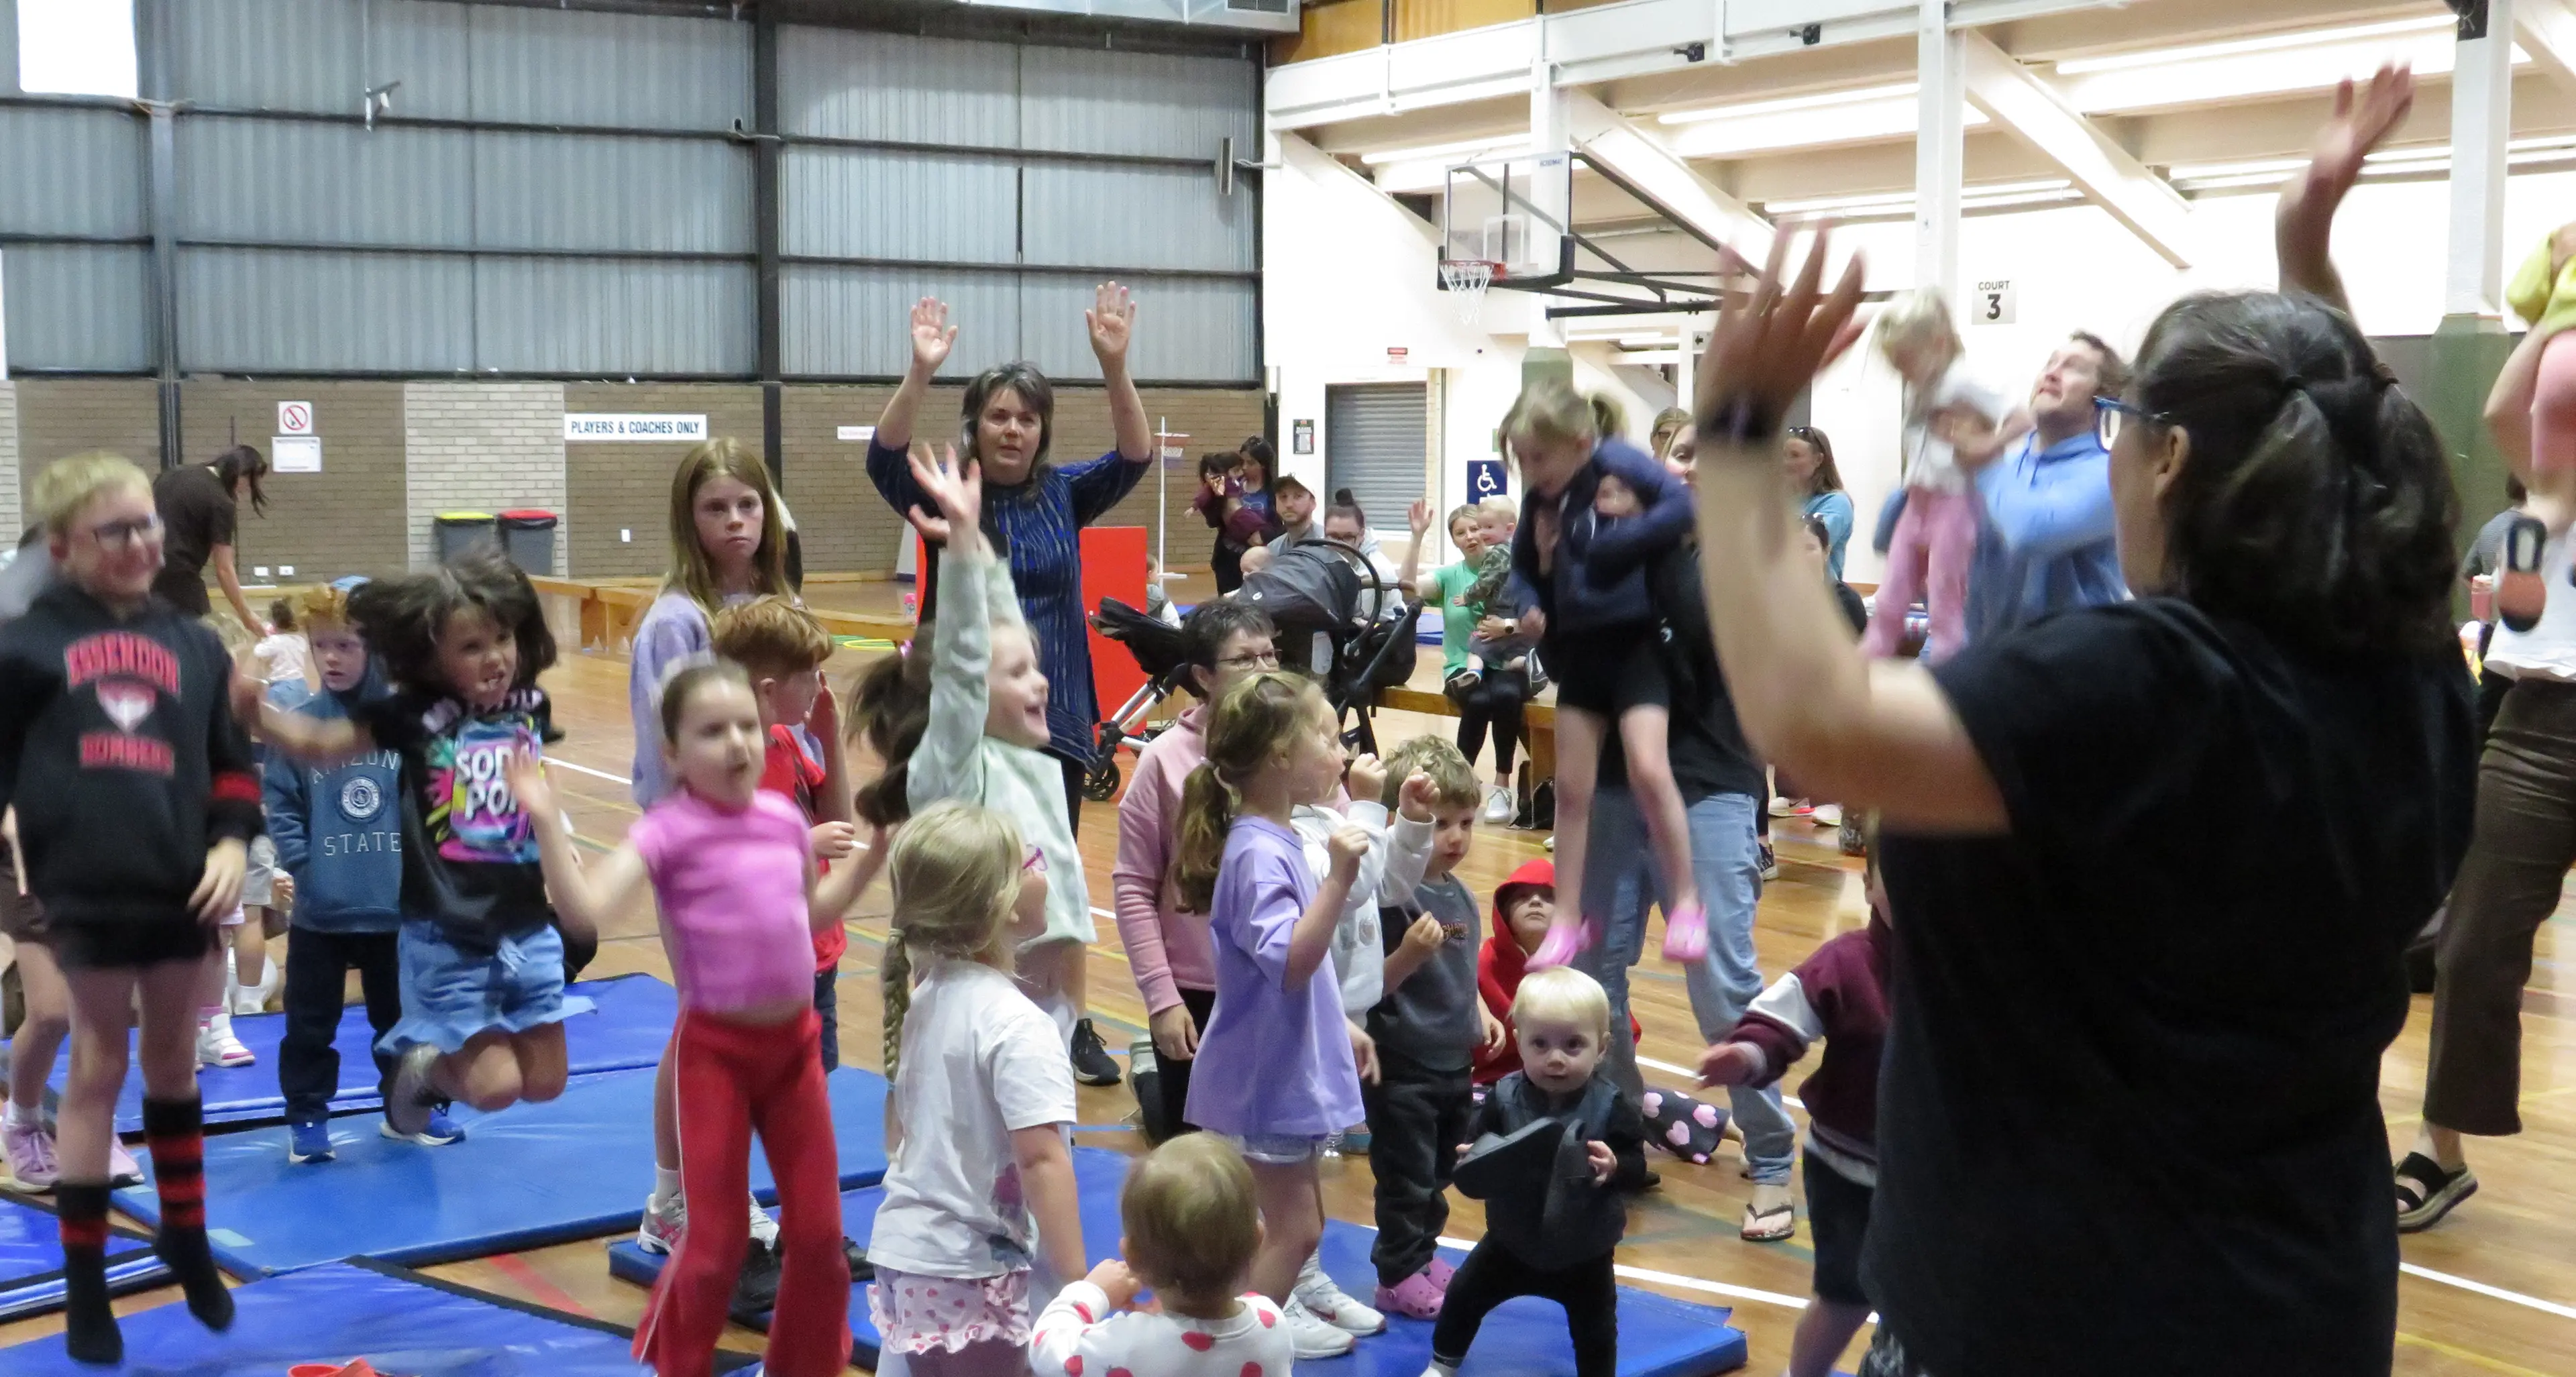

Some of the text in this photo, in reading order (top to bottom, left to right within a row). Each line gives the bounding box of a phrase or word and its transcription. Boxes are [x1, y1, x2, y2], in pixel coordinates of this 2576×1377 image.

[1978, 280, 2010, 290] COURT
[1986, 294, 2000, 320] 3
[571, 421, 700, 434] PLAYERS & COACHES ONLY
[455, 743, 534, 783] SOD
[323, 832, 402, 856] STATE
